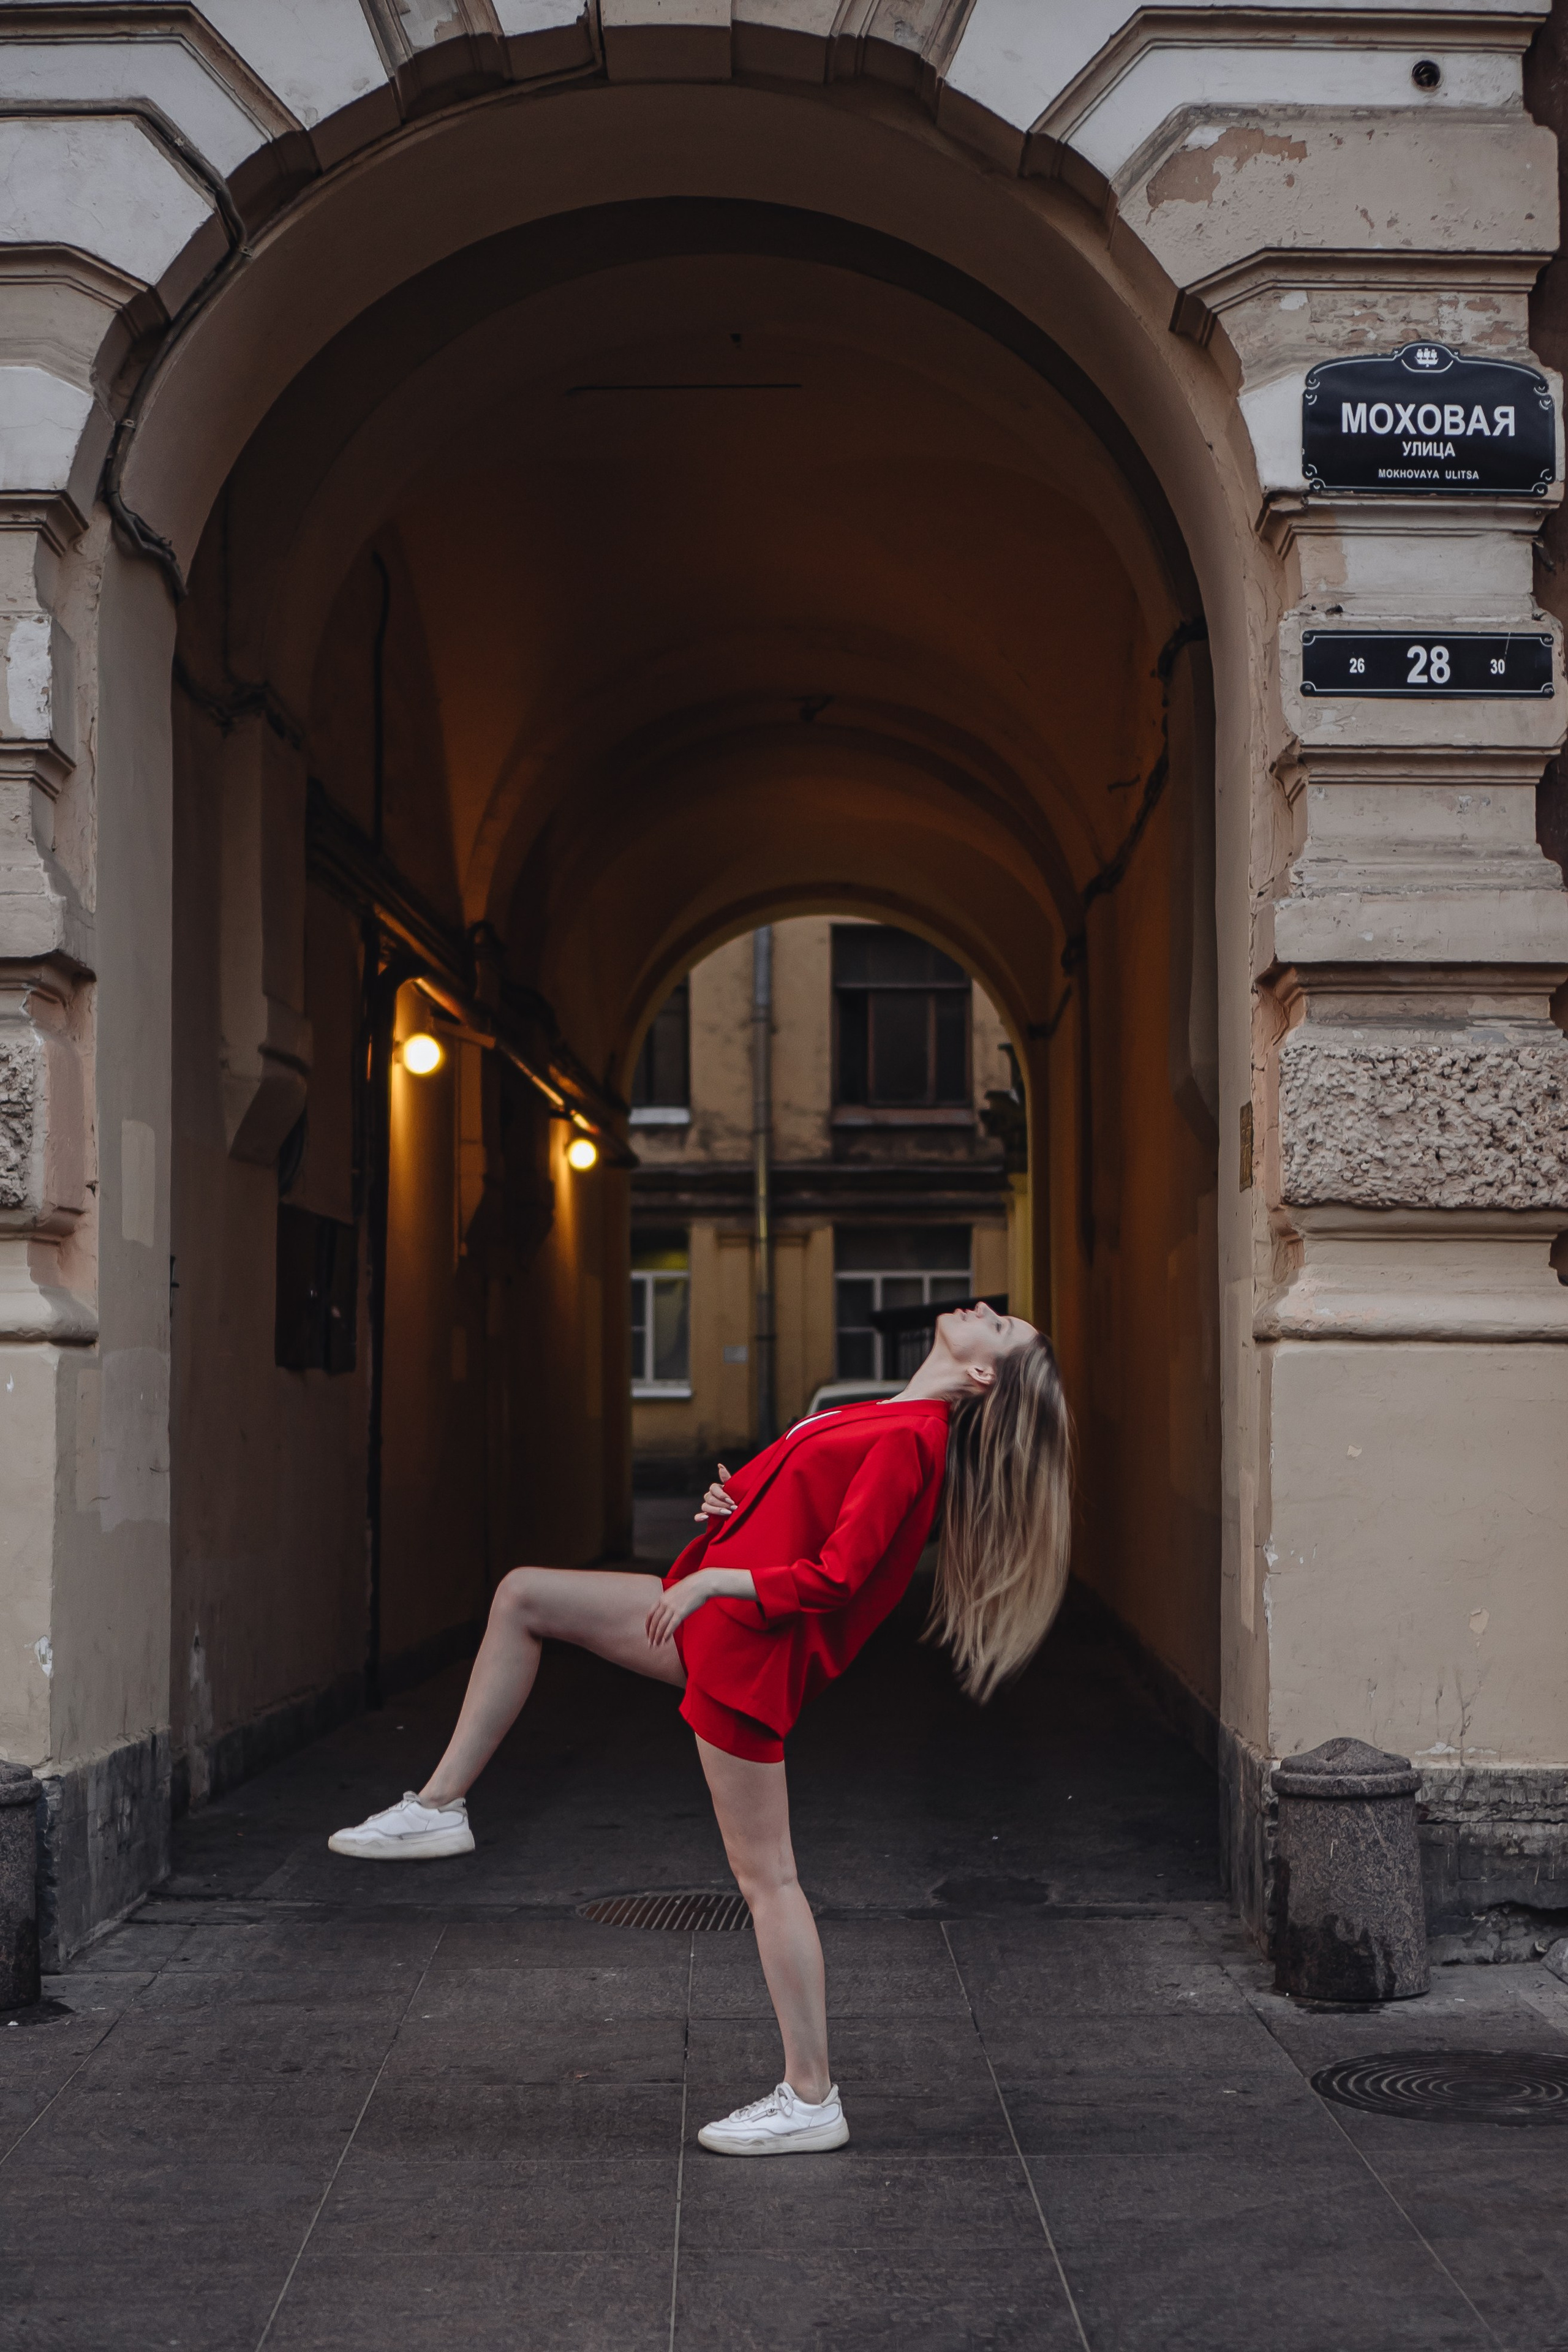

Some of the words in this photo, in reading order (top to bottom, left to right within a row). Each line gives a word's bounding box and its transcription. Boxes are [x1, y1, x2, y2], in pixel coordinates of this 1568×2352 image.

[1341, 402, 1515, 437] МОХОВАЯ
[1402, 441, 1456, 459] УЛИЦА
[1378, 469, 1439, 479] MOKHOVAYA
[1445, 470, 1479, 480] ULITSA
[1349, 657, 1365, 674] 26
[1406, 645, 1451, 684] 28
[1490, 658, 1506, 674] 30
